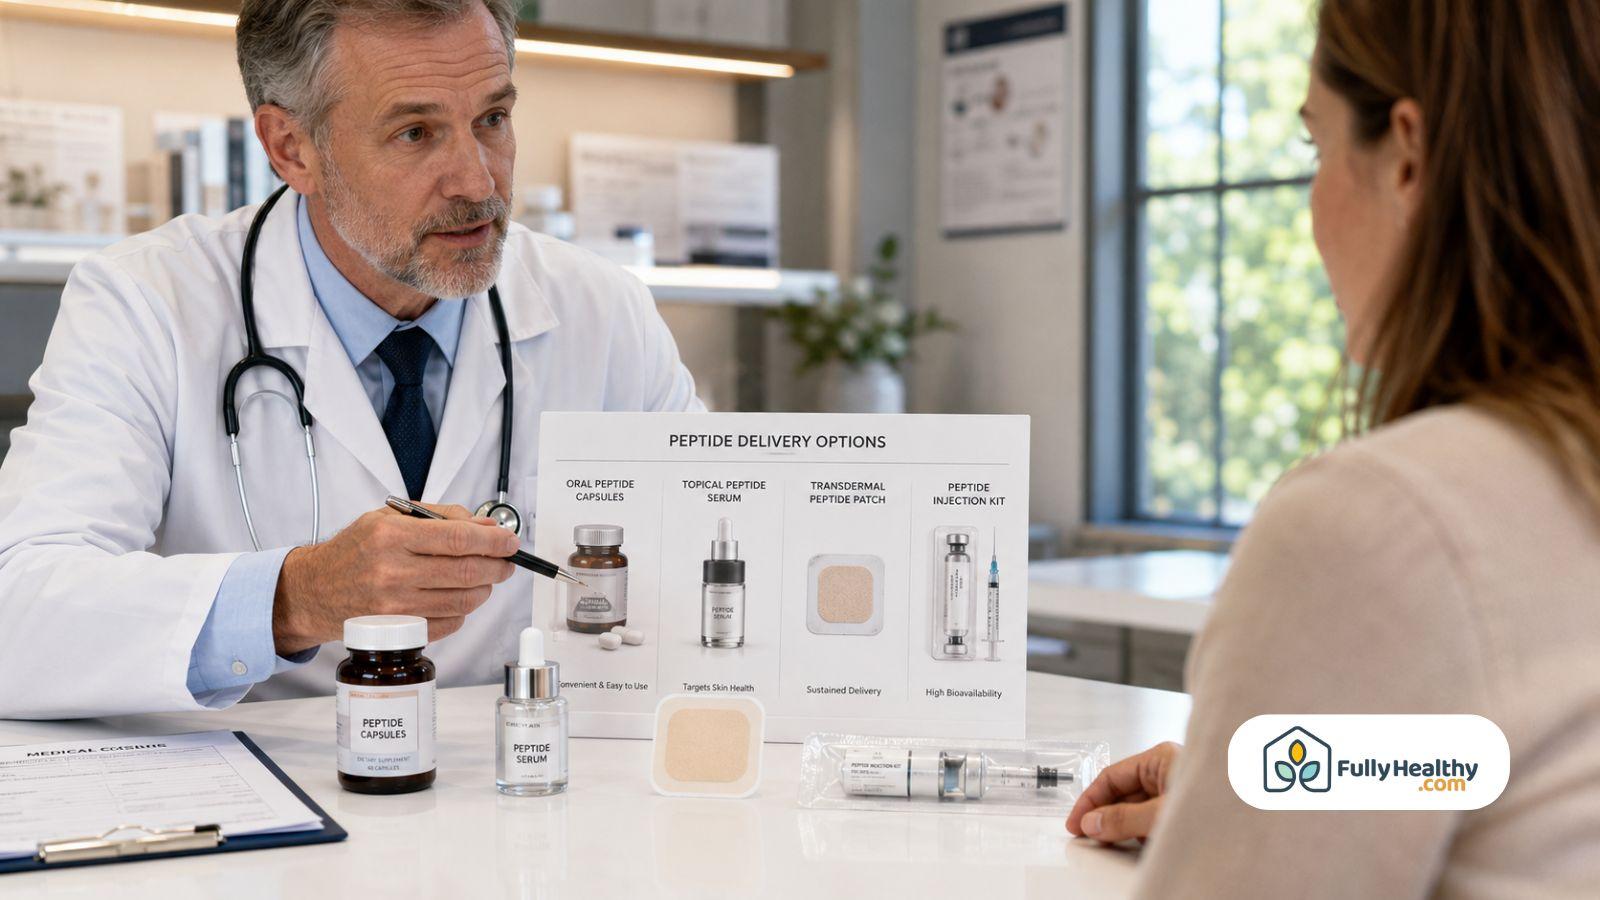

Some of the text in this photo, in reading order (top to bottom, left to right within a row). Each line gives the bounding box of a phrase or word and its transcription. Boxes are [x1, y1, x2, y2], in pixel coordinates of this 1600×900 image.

[669, 434, 886, 449] PEPTIDE DELIVERY OPTIONS
[566, 479, 634, 489] ORAL PEPTIDE
[682, 480, 766, 490] TOPICAL PEPTIDE
[810, 481, 886, 491] TRANSDERMAL
[948, 482, 990, 493] PEPTIDE
[575, 492, 625, 502] CAPSULES
[707, 493, 742, 503] SERUM
[809, 494, 886, 505] PEPTIDE PATCH
[933, 496, 1006, 506] INJECTION KIT
[598, 681, 605, 689] &
[606, 681, 624, 692] Easy
[624, 682, 633, 690] to
[634, 682, 649, 690] Use
[682, 682, 755, 693] Targets Skin Health
[806, 685, 882, 697] Sustained Delivery
[925, 688, 1003, 700] High Bioavailability
[362, 717, 404, 728] PEPTIDE
[360, 729, 407, 739] CAPSULES
[26, 748, 96, 757] MEDICAL
[513, 743, 551, 753] PEPTIDE
[516, 754, 548, 764] SERUM
